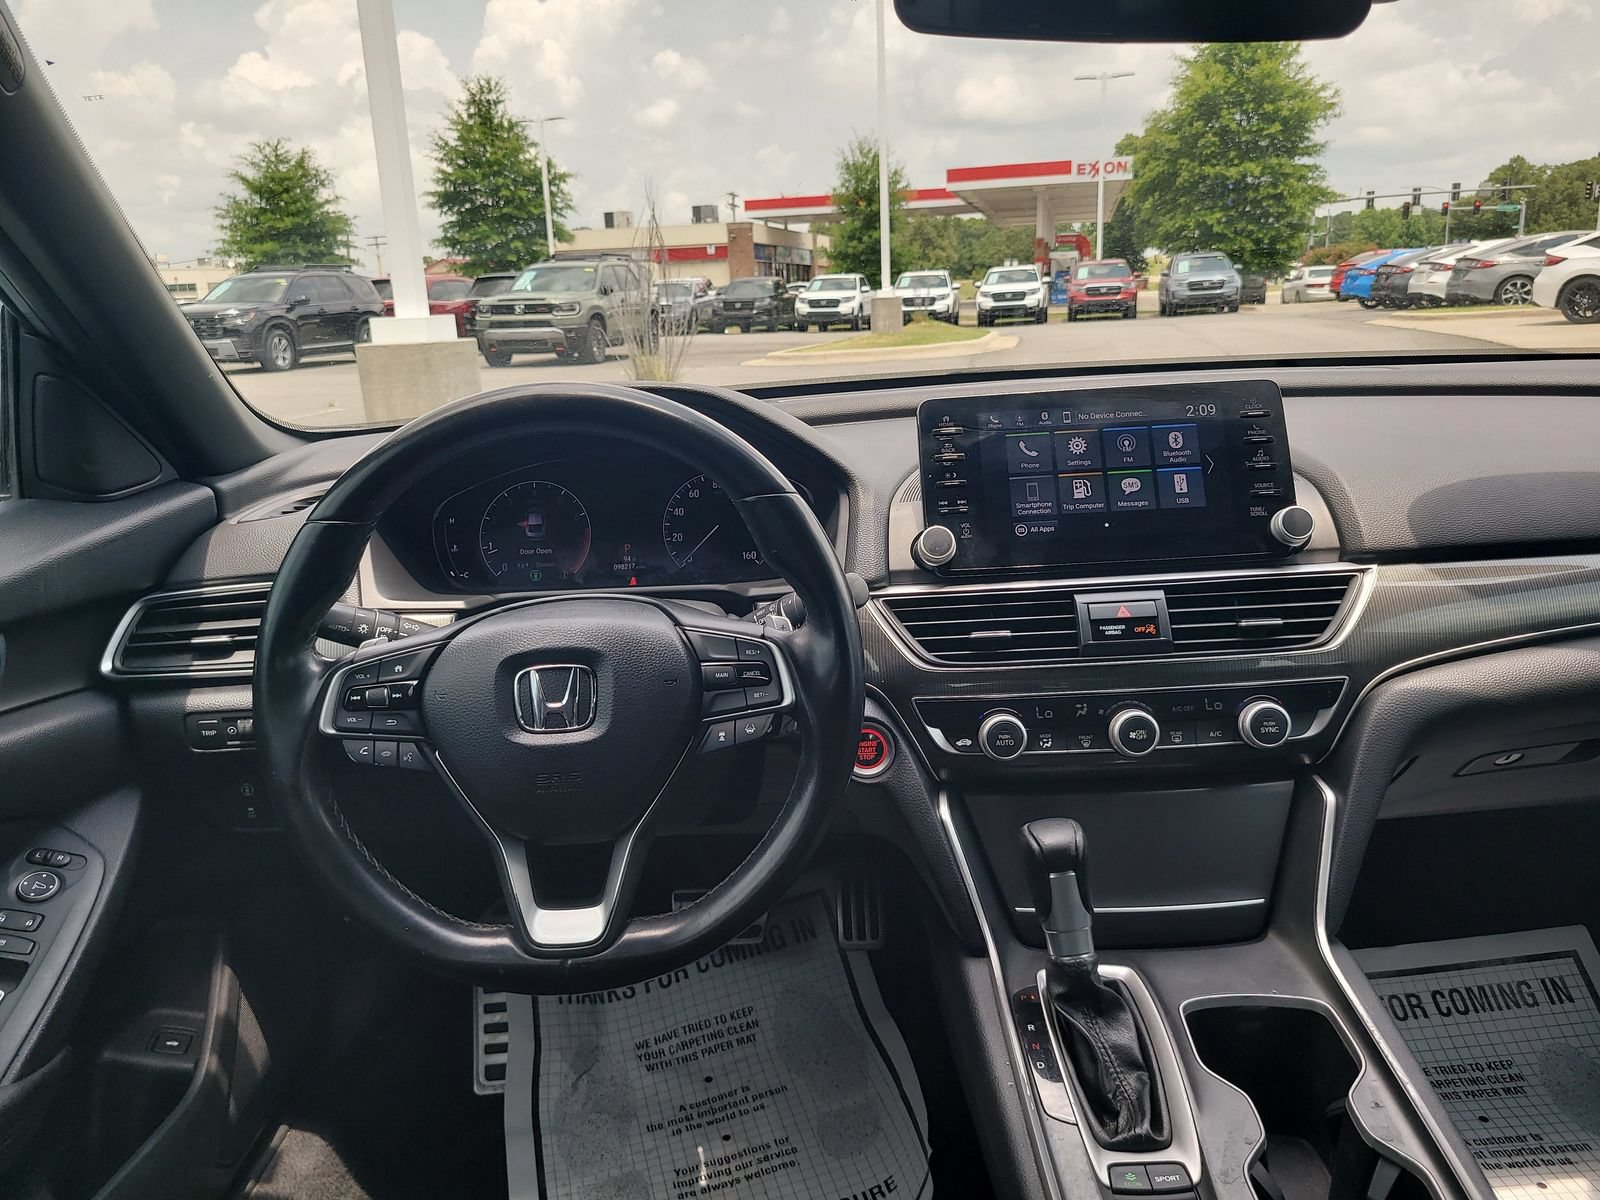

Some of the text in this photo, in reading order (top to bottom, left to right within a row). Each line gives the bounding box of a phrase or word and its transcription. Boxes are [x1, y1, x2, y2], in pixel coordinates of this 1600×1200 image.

[1090, 412, 1114, 420] Device
[1185, 404, 1216, 417] 2:09
[688, 489, 700, 498] 60
[1016, 501, 1052, 509] Smartphone
[1076, 502, 1105, 510] Computer
[1118, 500, 1149, 508] Messages
[674, 508, 684, 516] 40
[672, 533, 683, 542] 20
[520, 548, 553, 556] Door Open
[624, 544, 631, 553] P
[743, 551, 756, 560] 160
[790, 917, 818, 944] IN
[1431, 981, 1540, 1018] COMING
[1541, 976, 1576, 1005] IN
[635, 1006, 754, 1050] WE HAVE TRIED TO KEEP
[637, 1019, 760, 1062] YOUR CARPETING CLEAN
[645, 1034, 758, 1072] WITH THIS PAPER MAT
[1037, 1061, 1045, 1069] D
[1432, 1064, 1467, 1076] TRIED
[1467, 1062, 1484, 1073] TO
[1485, 1059, 1513, 1071] KEEP
[1487, 1072, 1526, 1084] CLEAN
[1462, 1088, 1502, 1099] PAPER
[1501, 1086, 1527, 1096] MAT
[678, 1104, 687, 1112] A
[689, 1090, 738, 1110] customer
[646, 1084, 788, 1132] the most important person
[672, 1127, 682, 1136] in
[685, 1121, 702, 1132] the
[705, 1112, 736, 1126] world
[739, 1107, 749, 1116] to
[1473, 1133, 1544, 1146] customer is
[673, 1135, 790, 1177] Your suggestions for
[1489, 1146, 1548, 1158] important
[1549, 1142, 1592, 1155] person
[672, 1145, 798, 1190] improving our service
[1481, 1160, 1503, 1171] the
[1505, 1158, 1541, 1169] world
[1541, 1158, 1554, 1167] to
[1154, 1175, 1180, 1183] SPORT
[677, 1188, 697, 1200] are
[700, 1175, 742, 1195] always
